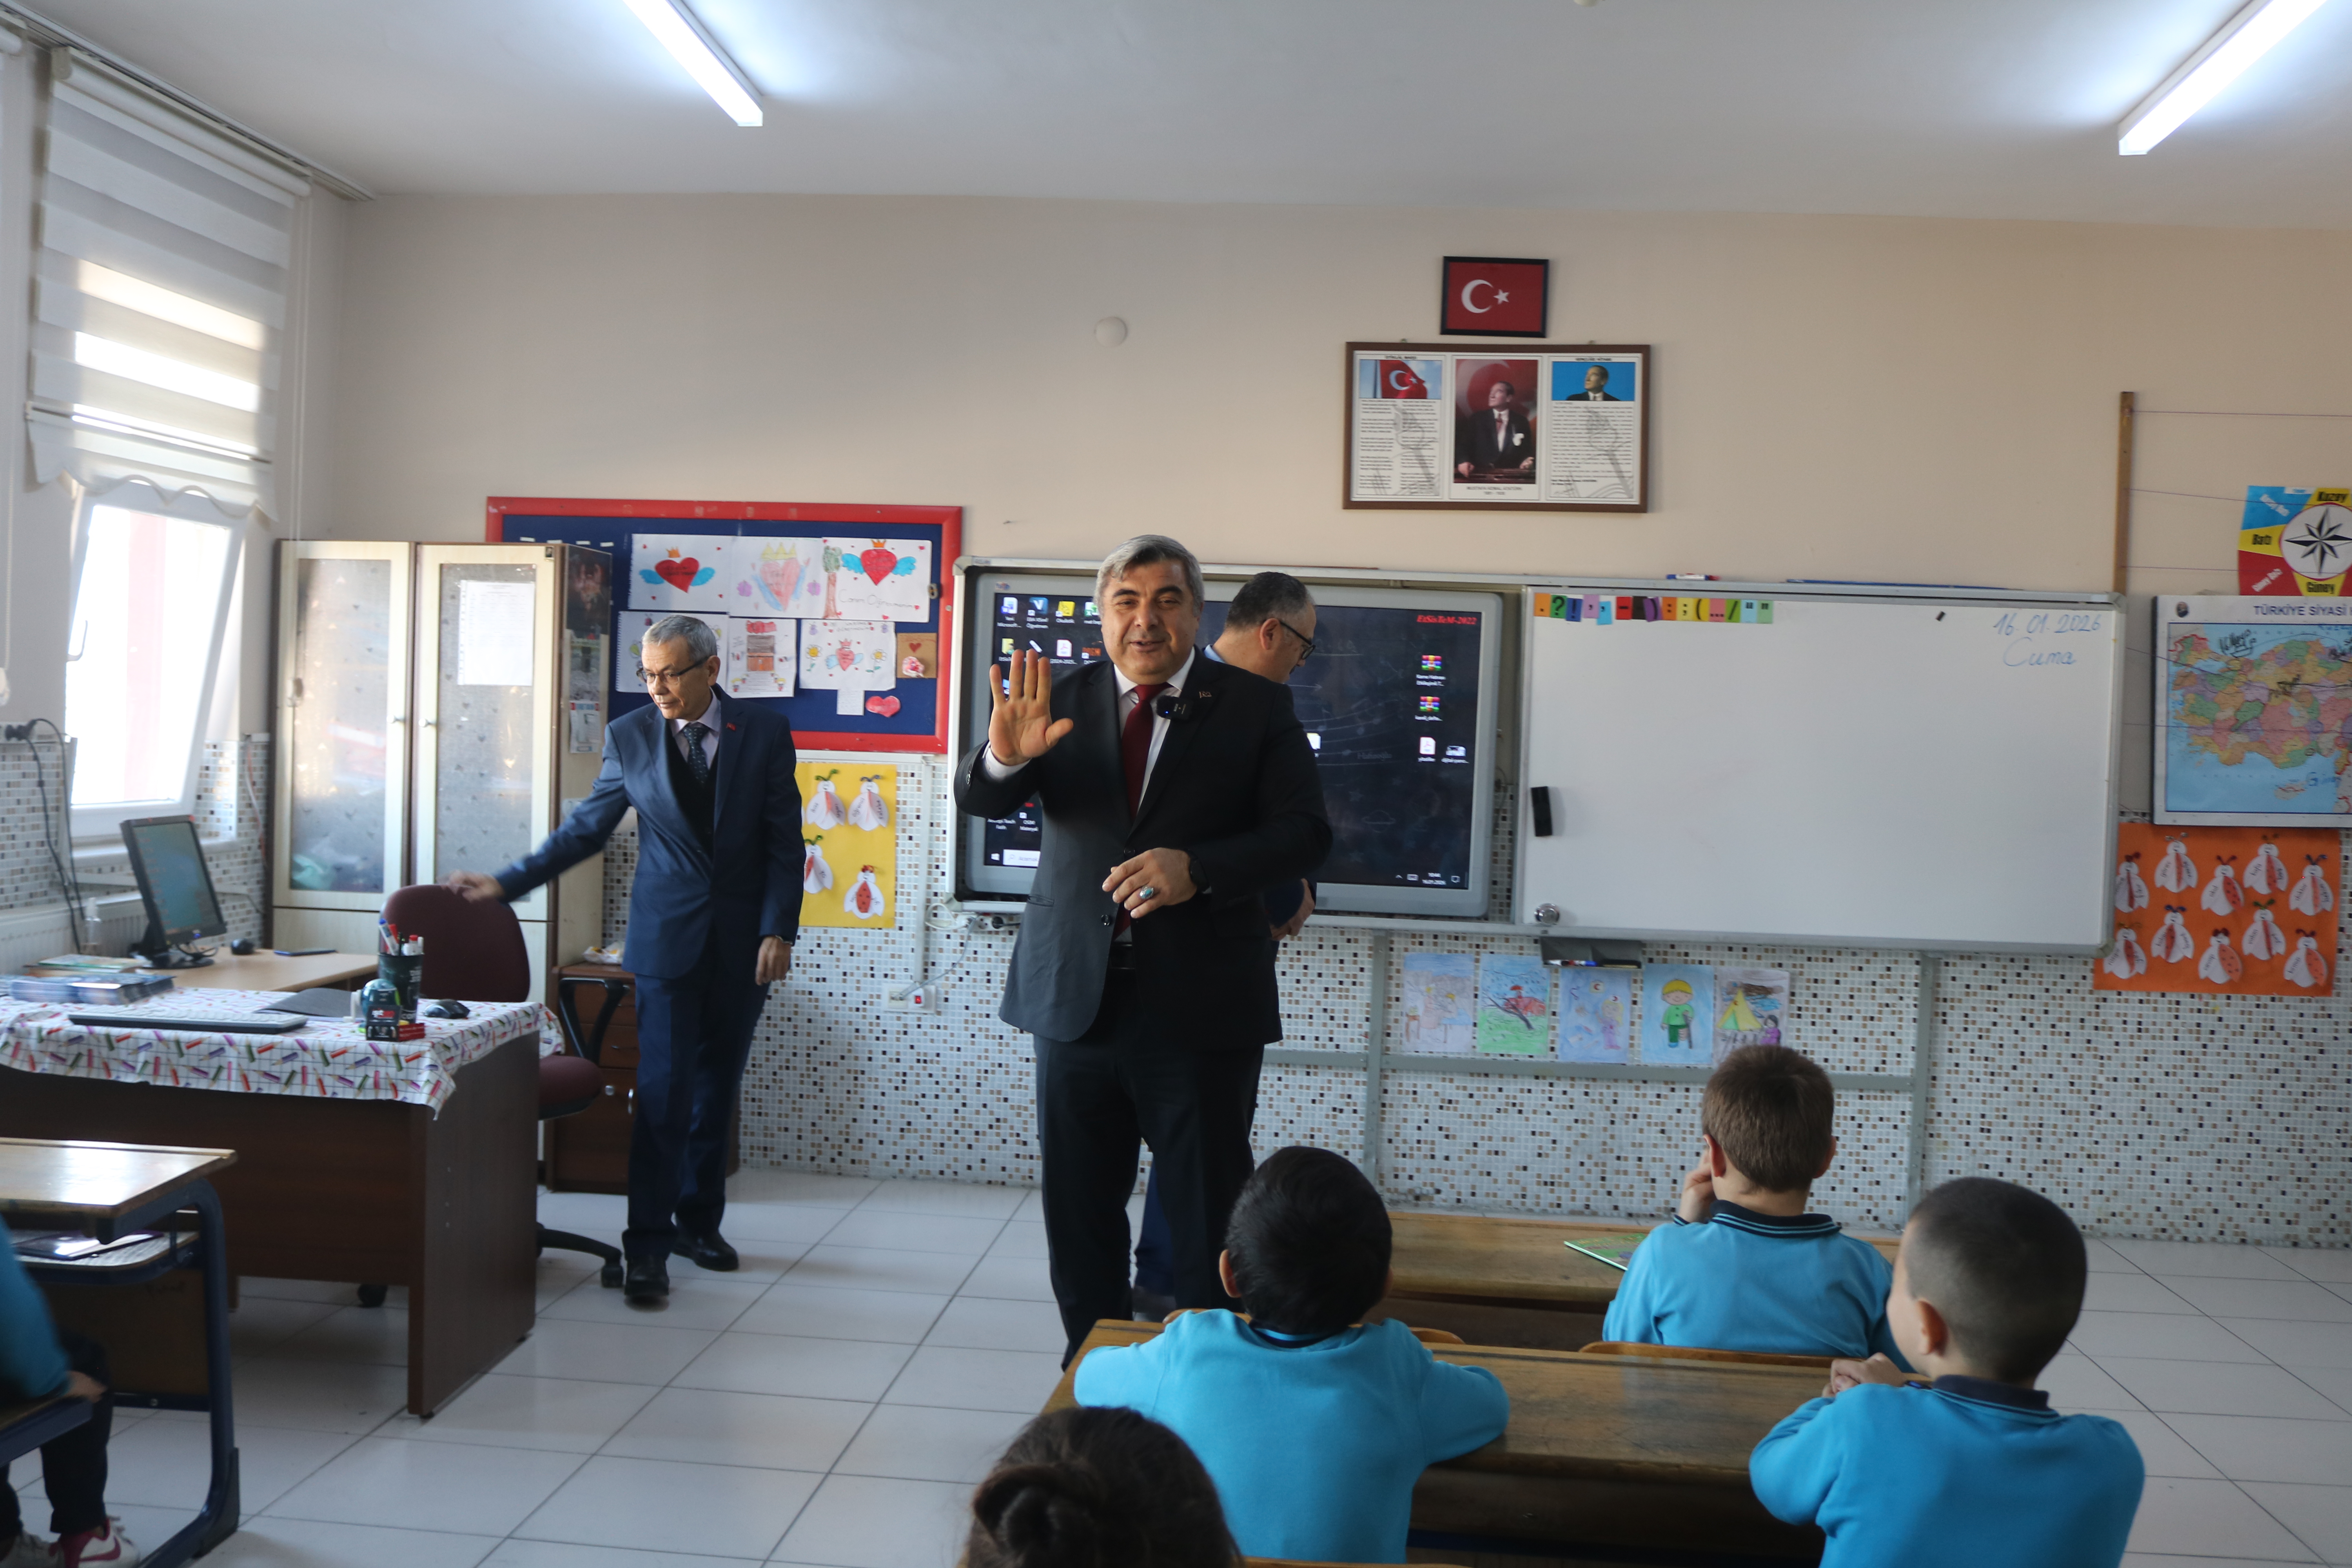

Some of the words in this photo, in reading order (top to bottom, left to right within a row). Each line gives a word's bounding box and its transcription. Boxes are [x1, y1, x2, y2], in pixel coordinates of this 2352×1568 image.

[2254, 604, 2305, 615] TÜRKİYE
[2309, 604, 2347, 615] SİYASİ
[2003, 637, 2077, 666] Cuma
